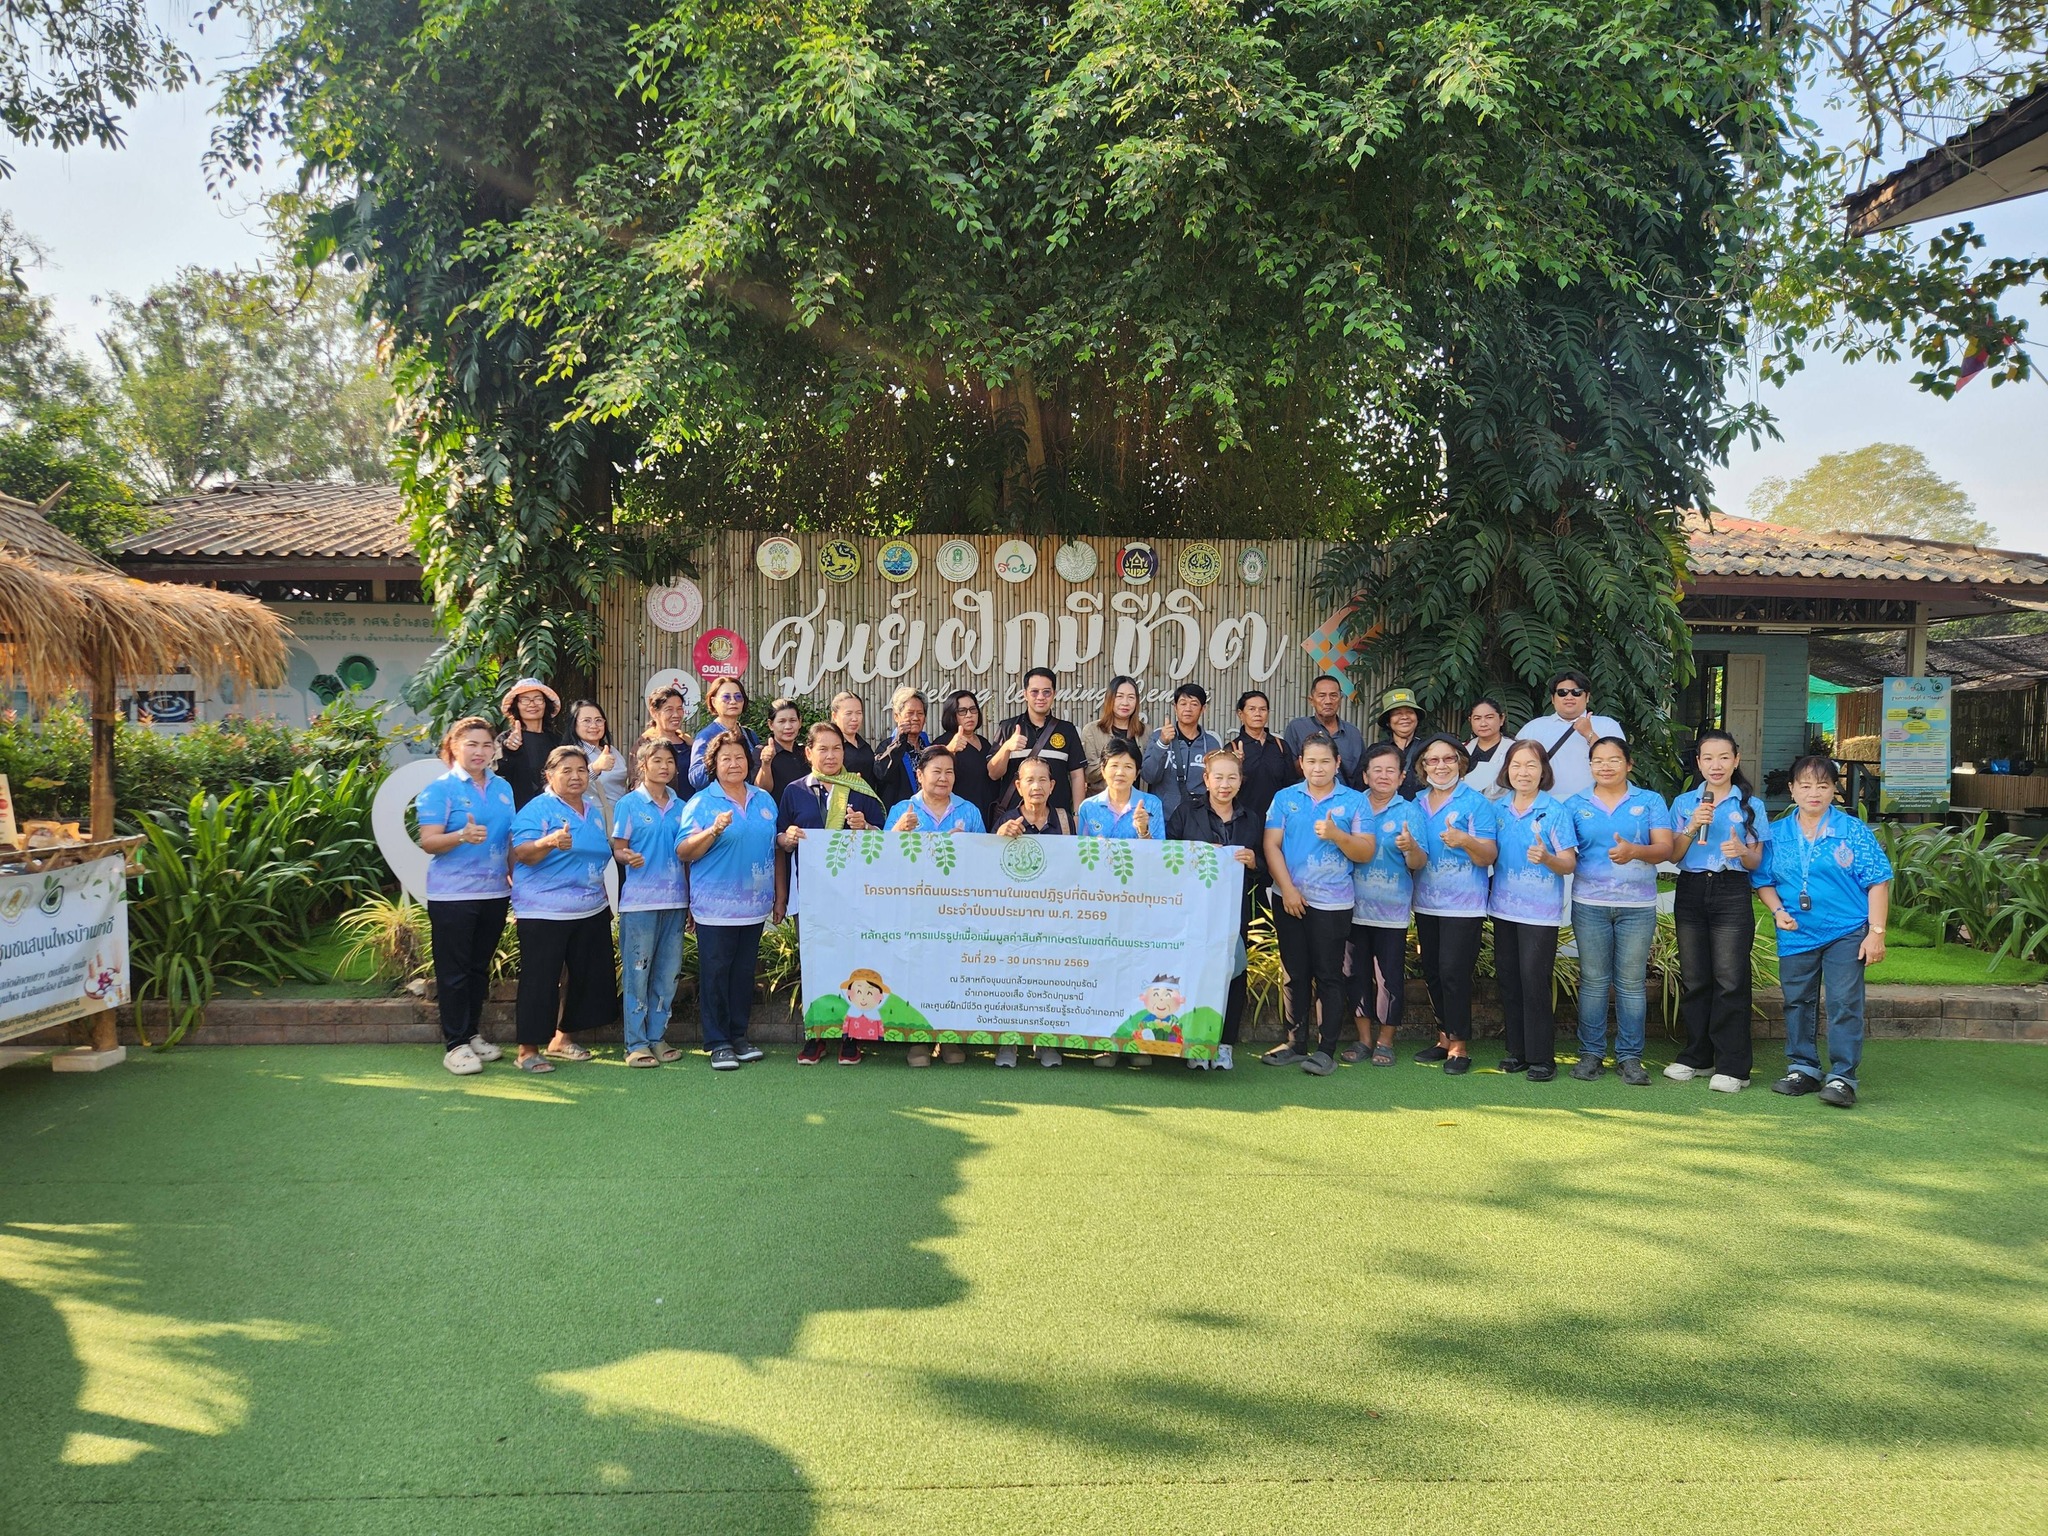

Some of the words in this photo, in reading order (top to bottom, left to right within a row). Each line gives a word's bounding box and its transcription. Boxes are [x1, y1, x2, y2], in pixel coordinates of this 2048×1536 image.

[758, 587, 1289, 698] ศูนย์ฝึกมีชีวิต
[702, 663, 738, 675] ออมสิน
[864, 879, 1183, 909] โครงการที่ดินพระราชทานในเขตปฏิรูปที่ดินจังหวัดปทุมธานี
[938, 902, 1045, 918] ประจำปีงบประมาณ
[1049, 908, 1073, 919] พ.ศ.
[1077, 909, 1107, 921] 2569
[860, 929, 902, 943] หลักสูตร
[961, 950, 981, 964] วันที่
[983, 955, 997, 964] 29
[1007, 956, 1020, 965] 30
[1022, 956, 1061, 967] มกราคม
[1064, 957, 1090, 968] 2569
[949, 976, 958, 984] ณ
[965, 987, 1025, 998] อำเภอหนองเสือ
[1026, 990, 1085, 1002] จังหวัดปทุมธานี
[920, 1000, 983, 1012] และศูนย์ฝึกมีชีวิต
[976, 1015, 1071, 1029] จังหวัดพระนครศรีอยุธยา
